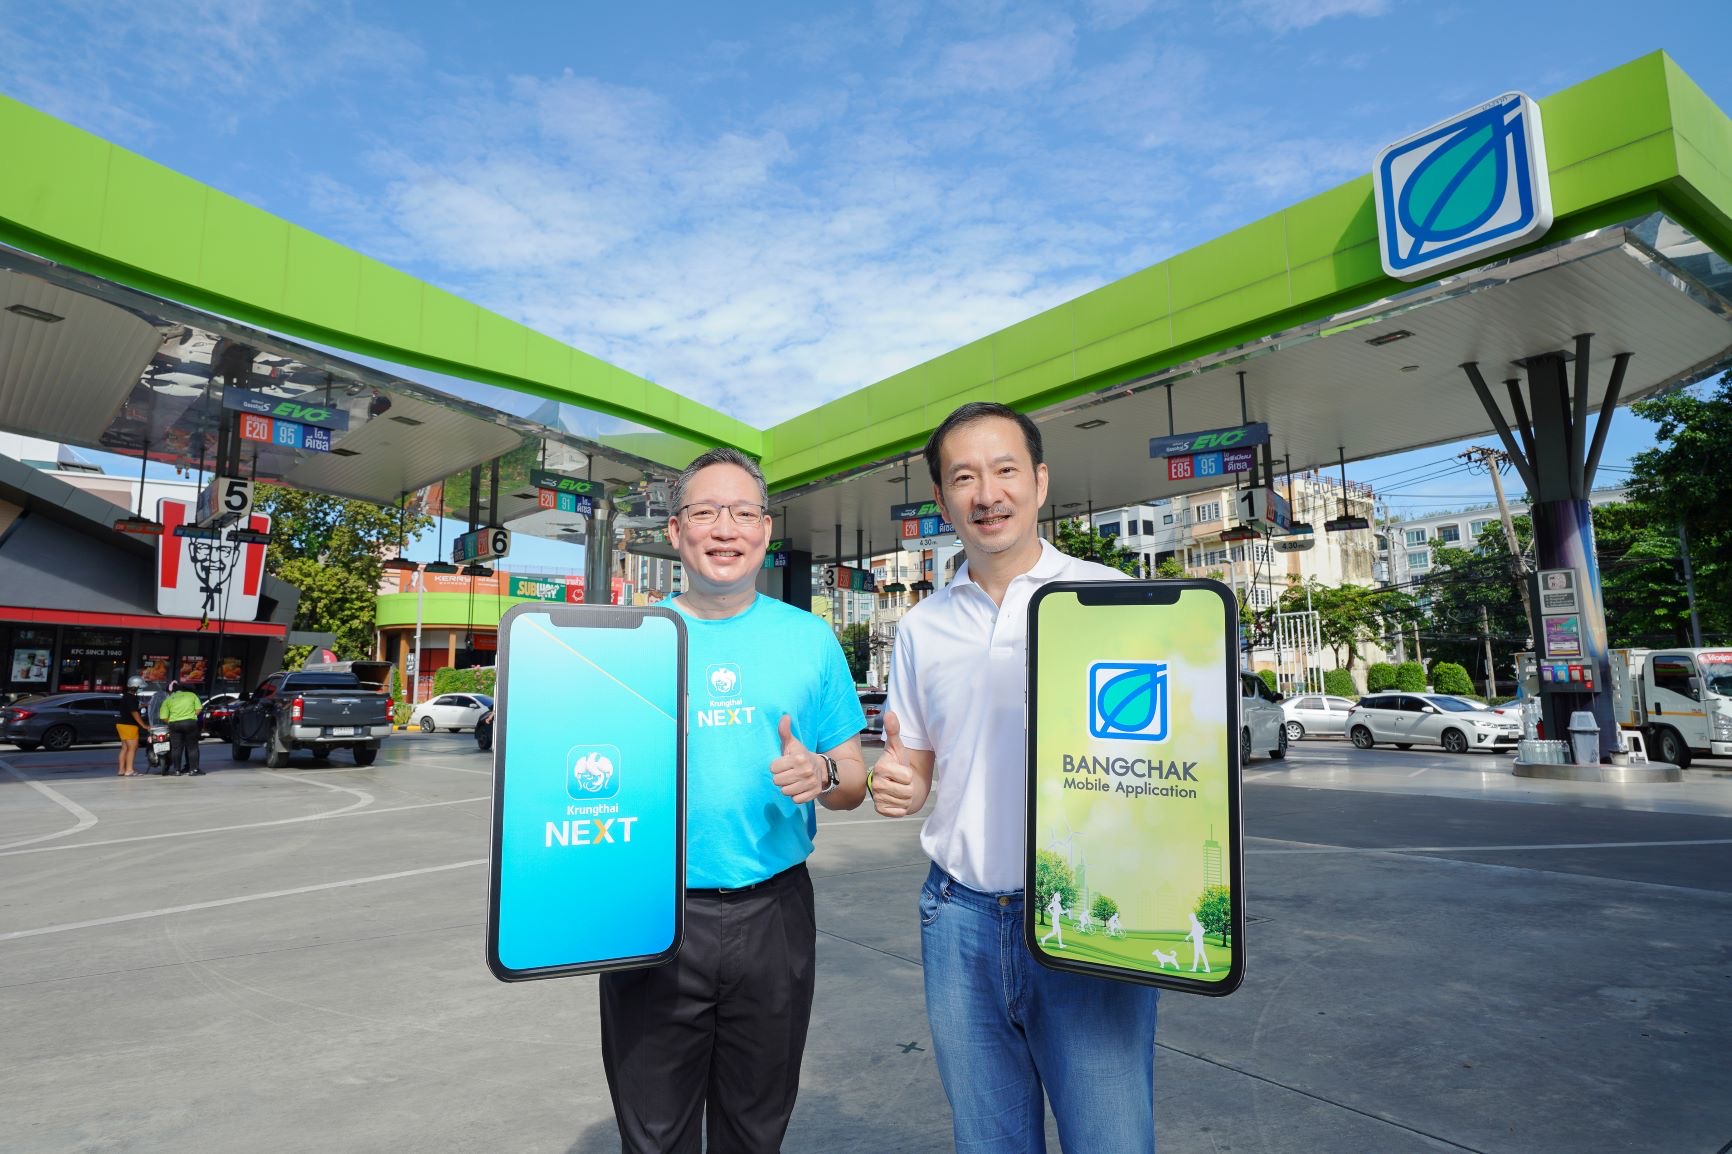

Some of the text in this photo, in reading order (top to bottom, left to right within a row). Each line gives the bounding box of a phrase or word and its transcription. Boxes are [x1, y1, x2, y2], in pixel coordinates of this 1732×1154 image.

[272, 402, 333, 422] EVO
[246, 421, 296, 445] E20 95
[304, 435, 329, 451] ดีเซล
[1191, 427, 1249, 450] EVO
[1171, 458, 1216, 479] E85 95
[1227, 461, 1248, 472] ดีเซล
[224, 480, 249, 511] 5
[557, 479, 594, 493] EVO
[540, 494, 554, 507] E20
[917, 503, 941, 516] EV
[1241, 490, 1256, 518] 1
[905, 521, 934, 537] E20 95
[492, 530, 508, 554] 6
[1281, 541, 1298, 550] 4.30
[825, 569, 835, 587] 3
[517, 580, 560, 600] SUBWAY
[709, 699, 743, 708] Krungthai
[697, 706, 756, 727] NEXT
[1062, 754, 1199, 782] BANGCHAK
[1063, 777, 1197, 798] Mobile Application
[566, 803, 619, 816] Krungthai
[545, 817, 638, 847] NEXT
